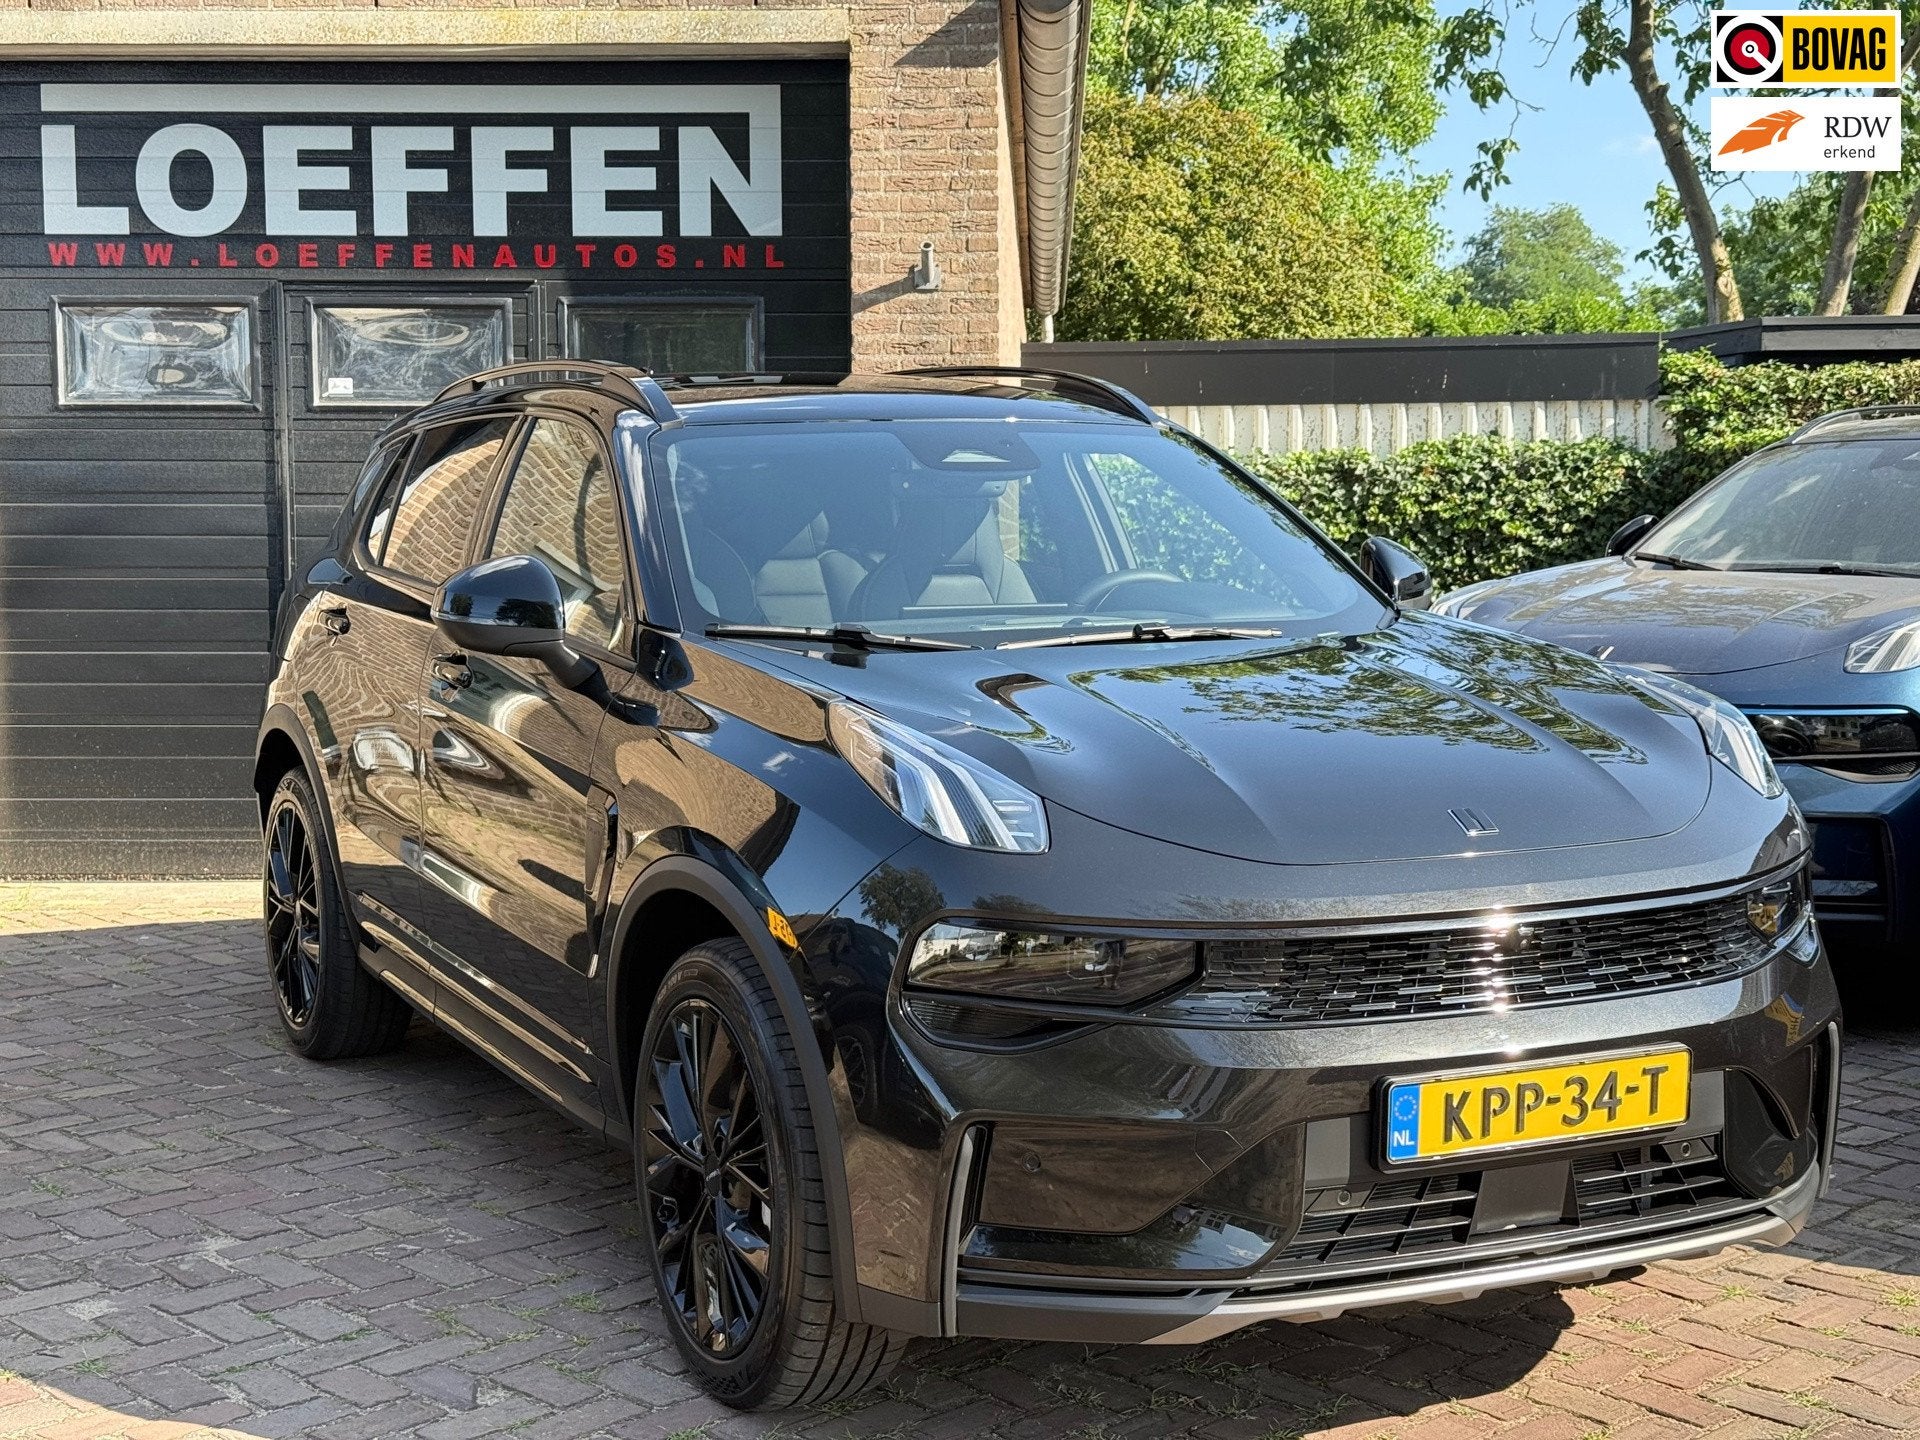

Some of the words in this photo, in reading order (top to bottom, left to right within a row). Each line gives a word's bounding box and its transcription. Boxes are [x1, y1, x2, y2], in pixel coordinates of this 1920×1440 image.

[41, 122, 783, 237] LOEFFEN
[50, 243, 785, 268] WWW.LOEFFENAUTOS.NL
[1393, 1130, 1415, 1147] NL
[1443, 1065, 1669, 1144] KPP-34-T
